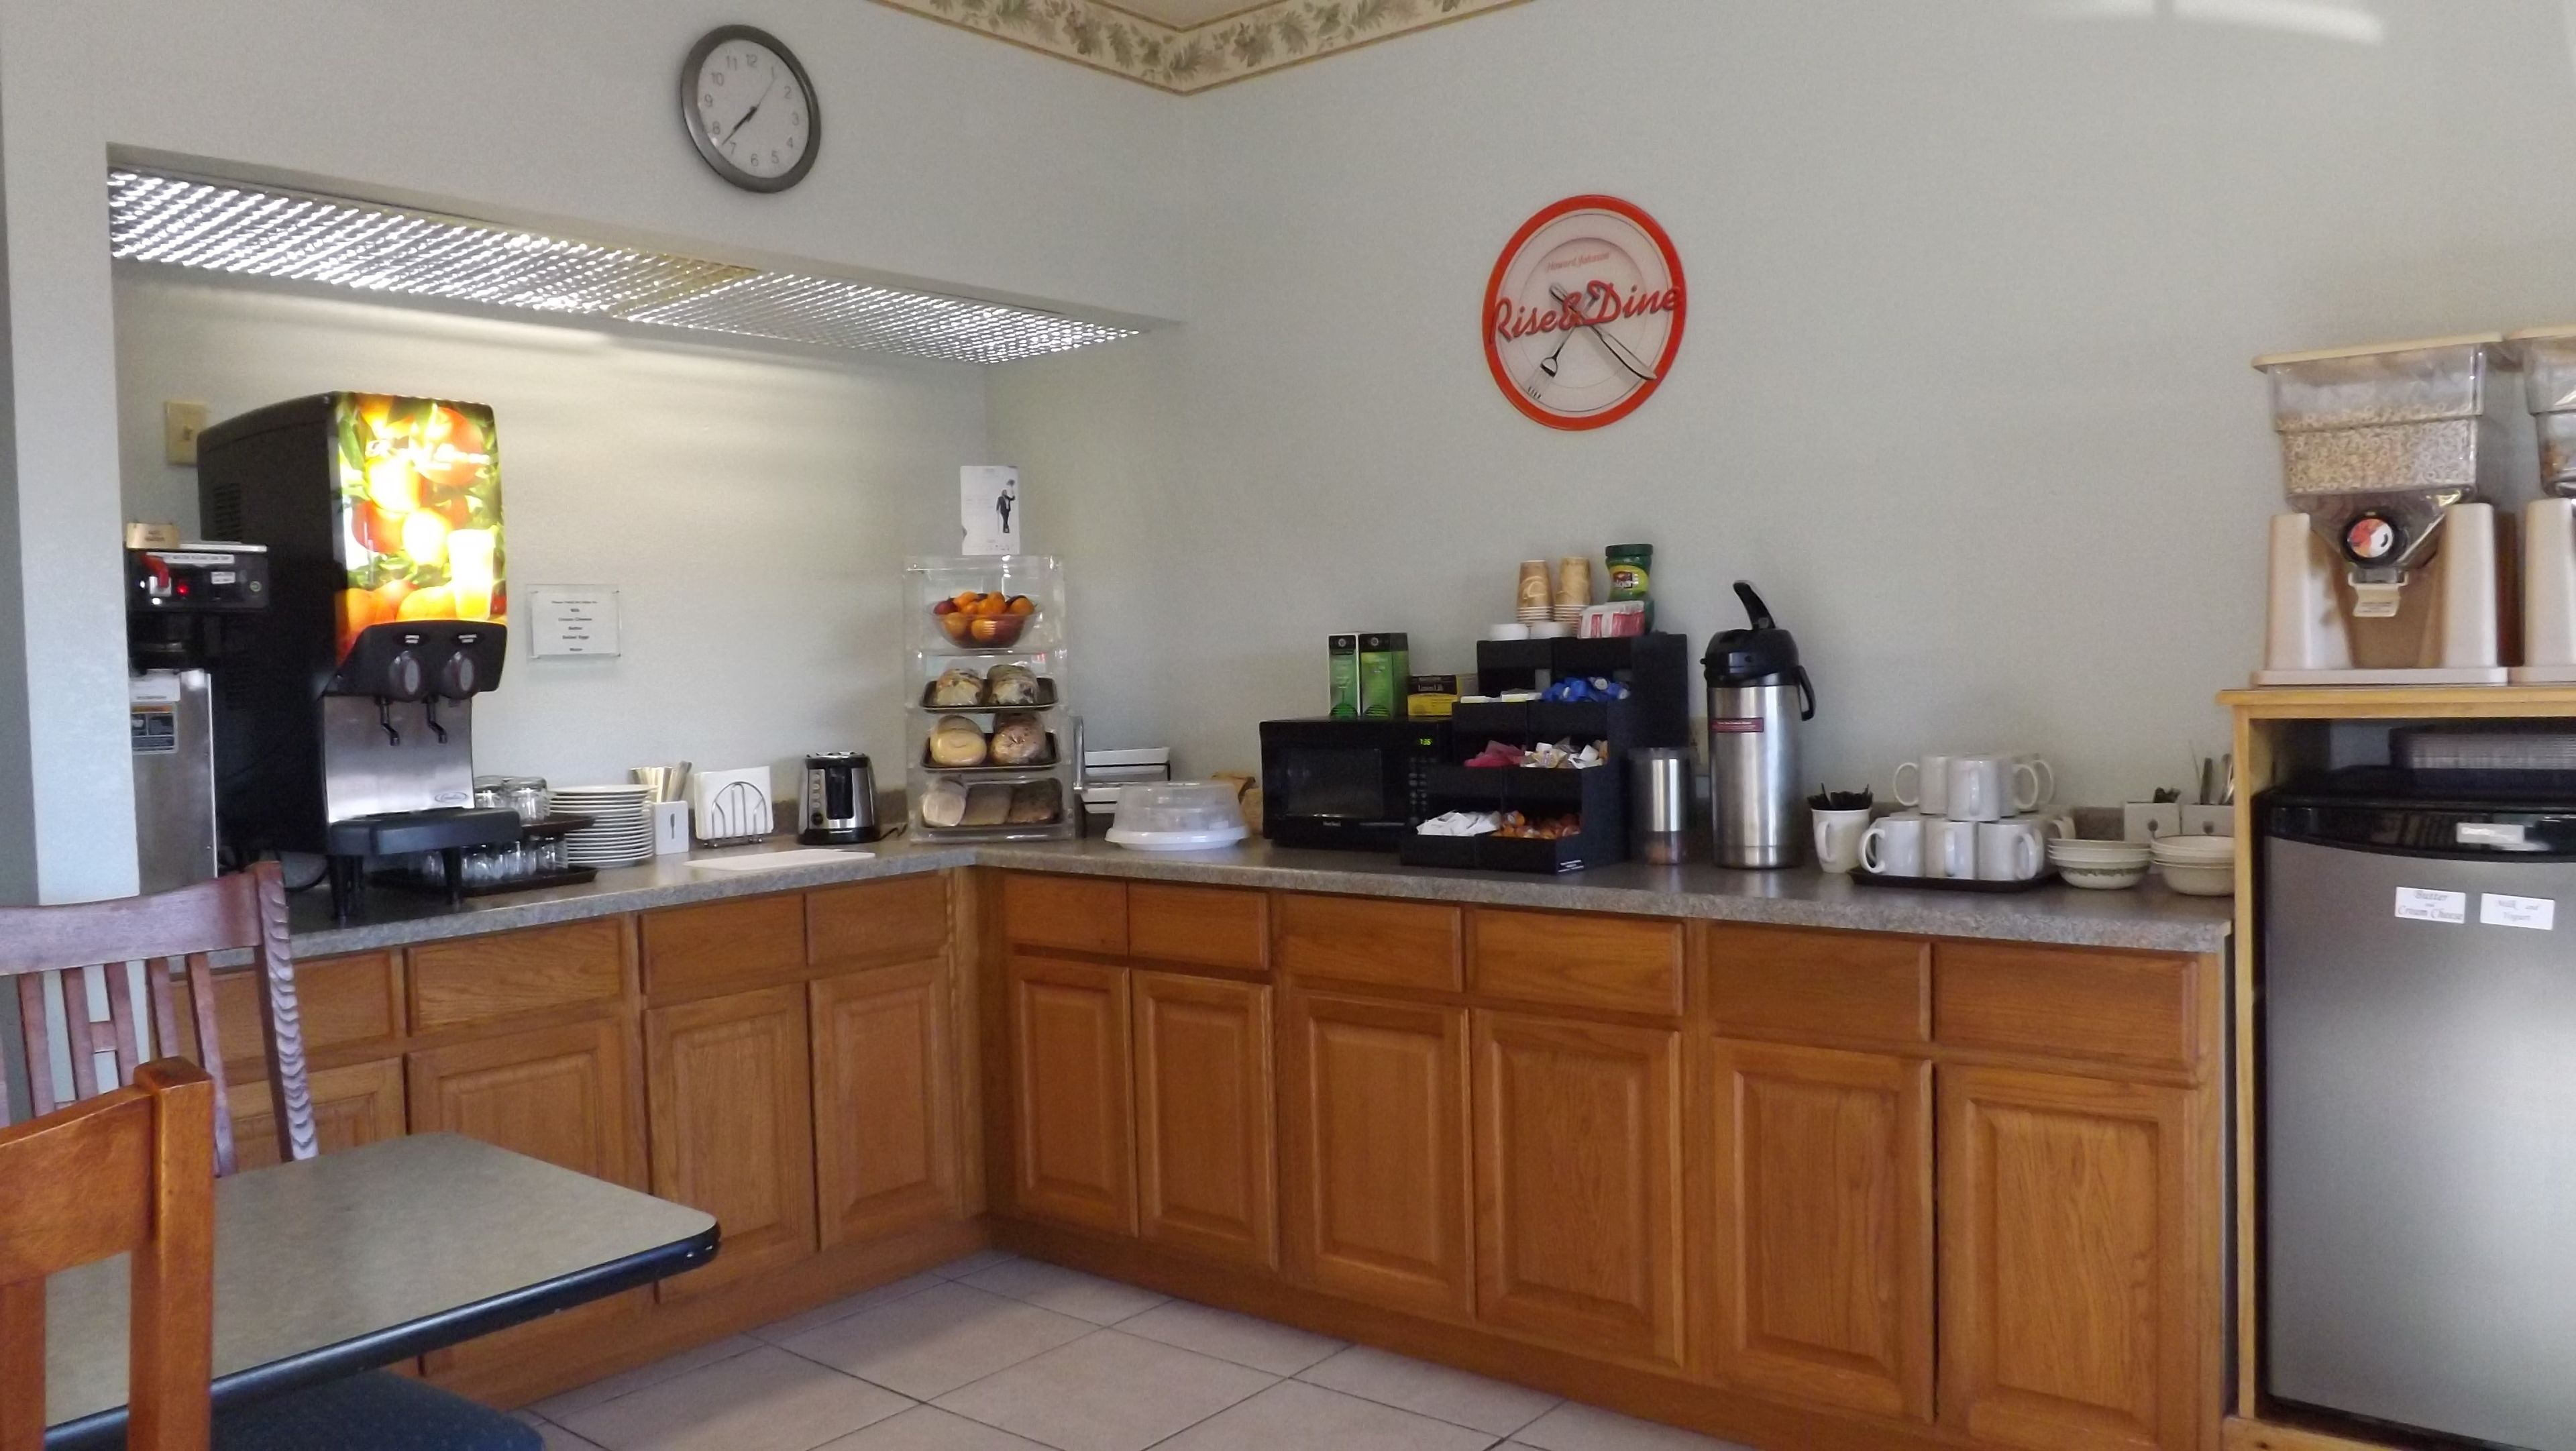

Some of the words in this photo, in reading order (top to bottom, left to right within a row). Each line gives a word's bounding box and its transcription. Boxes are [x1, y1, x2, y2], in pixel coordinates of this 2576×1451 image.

[727, 55, 737, 70] 11
[746, 54, 757, 67] 12
[711, 72, 724, 87] 10
[784, 86, 792, 99] 2
[705, 94, 713, 107] 9
[792, 112, 800, 126] 3
[712, 121, 720, 135] 8
[729, 142, 737, 155] 7
[786, 137, 794, 148] 4
[750, 154, 759, 167] 6
[771, 151, 780, 164] 5
